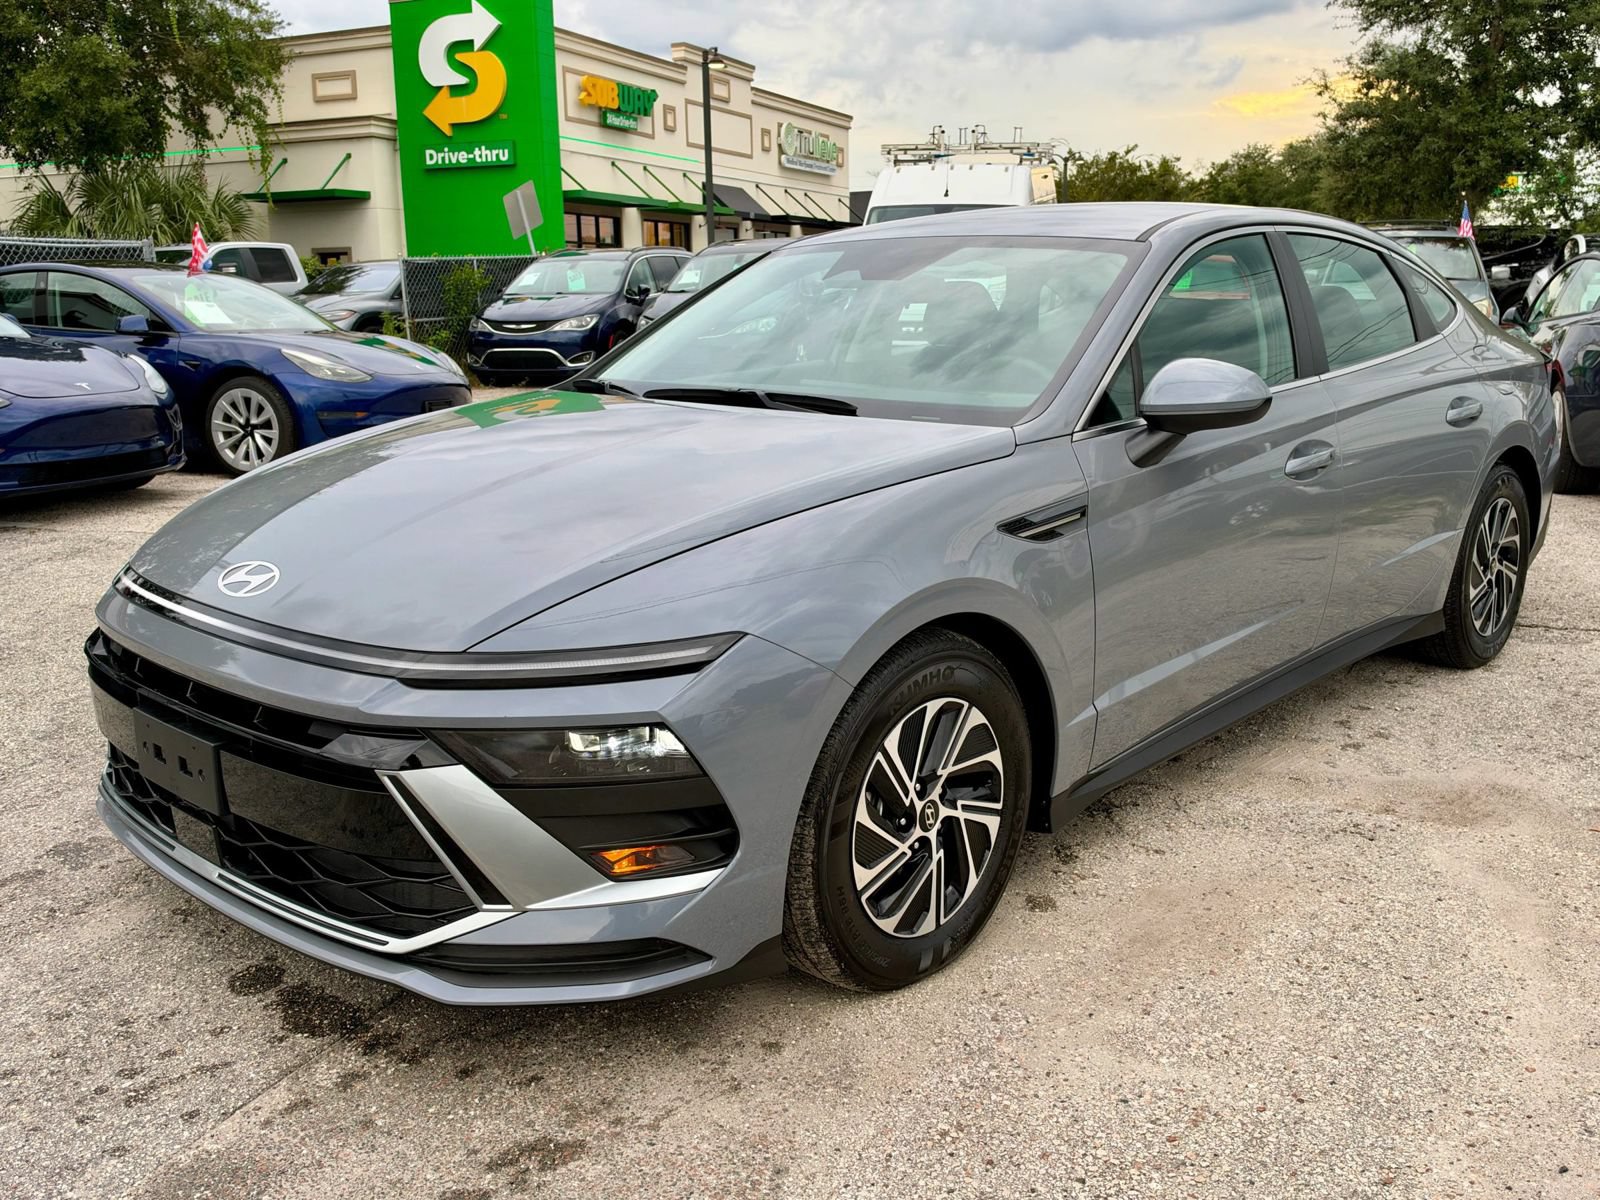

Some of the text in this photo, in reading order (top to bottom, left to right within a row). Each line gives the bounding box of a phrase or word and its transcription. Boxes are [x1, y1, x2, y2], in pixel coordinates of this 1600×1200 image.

[578, 75, 659, 117] SUBWAY
[424, 145, 509, 165] Drive-thru
[795, 129, 838, 162] Trulieve
